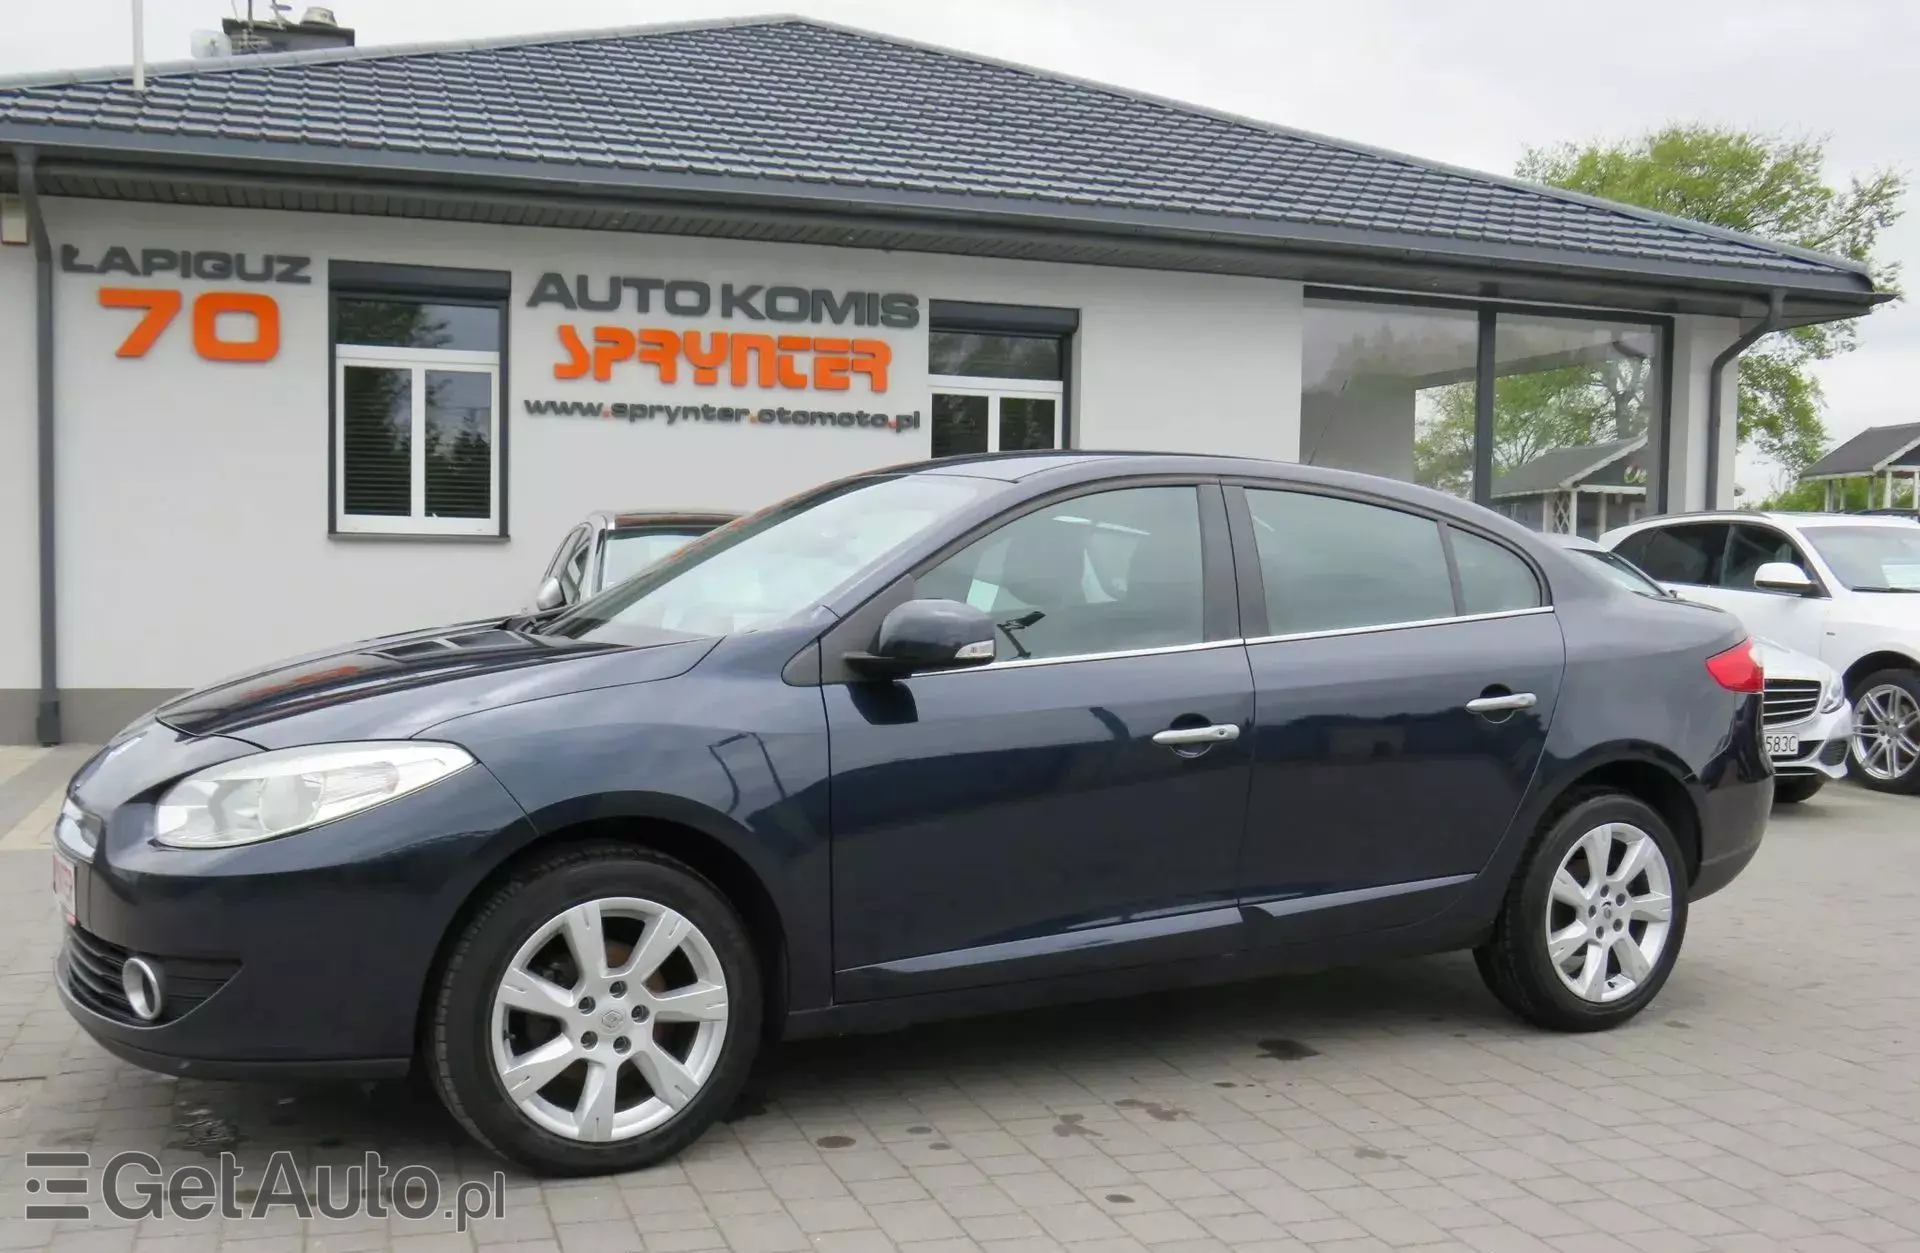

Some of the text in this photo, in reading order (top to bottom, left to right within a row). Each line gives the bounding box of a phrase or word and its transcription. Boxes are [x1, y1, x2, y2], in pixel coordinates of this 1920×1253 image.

[60, 243, 312, 283] ŁAPIGUZ
[98, 287, 280, 362] 70
[526, 272, 920, 328] AUTO KOMIS
[554, 324, 892, 393] SPRYNTER
[525, 399, 921, 434] www.sprynter.otomoto.pl
